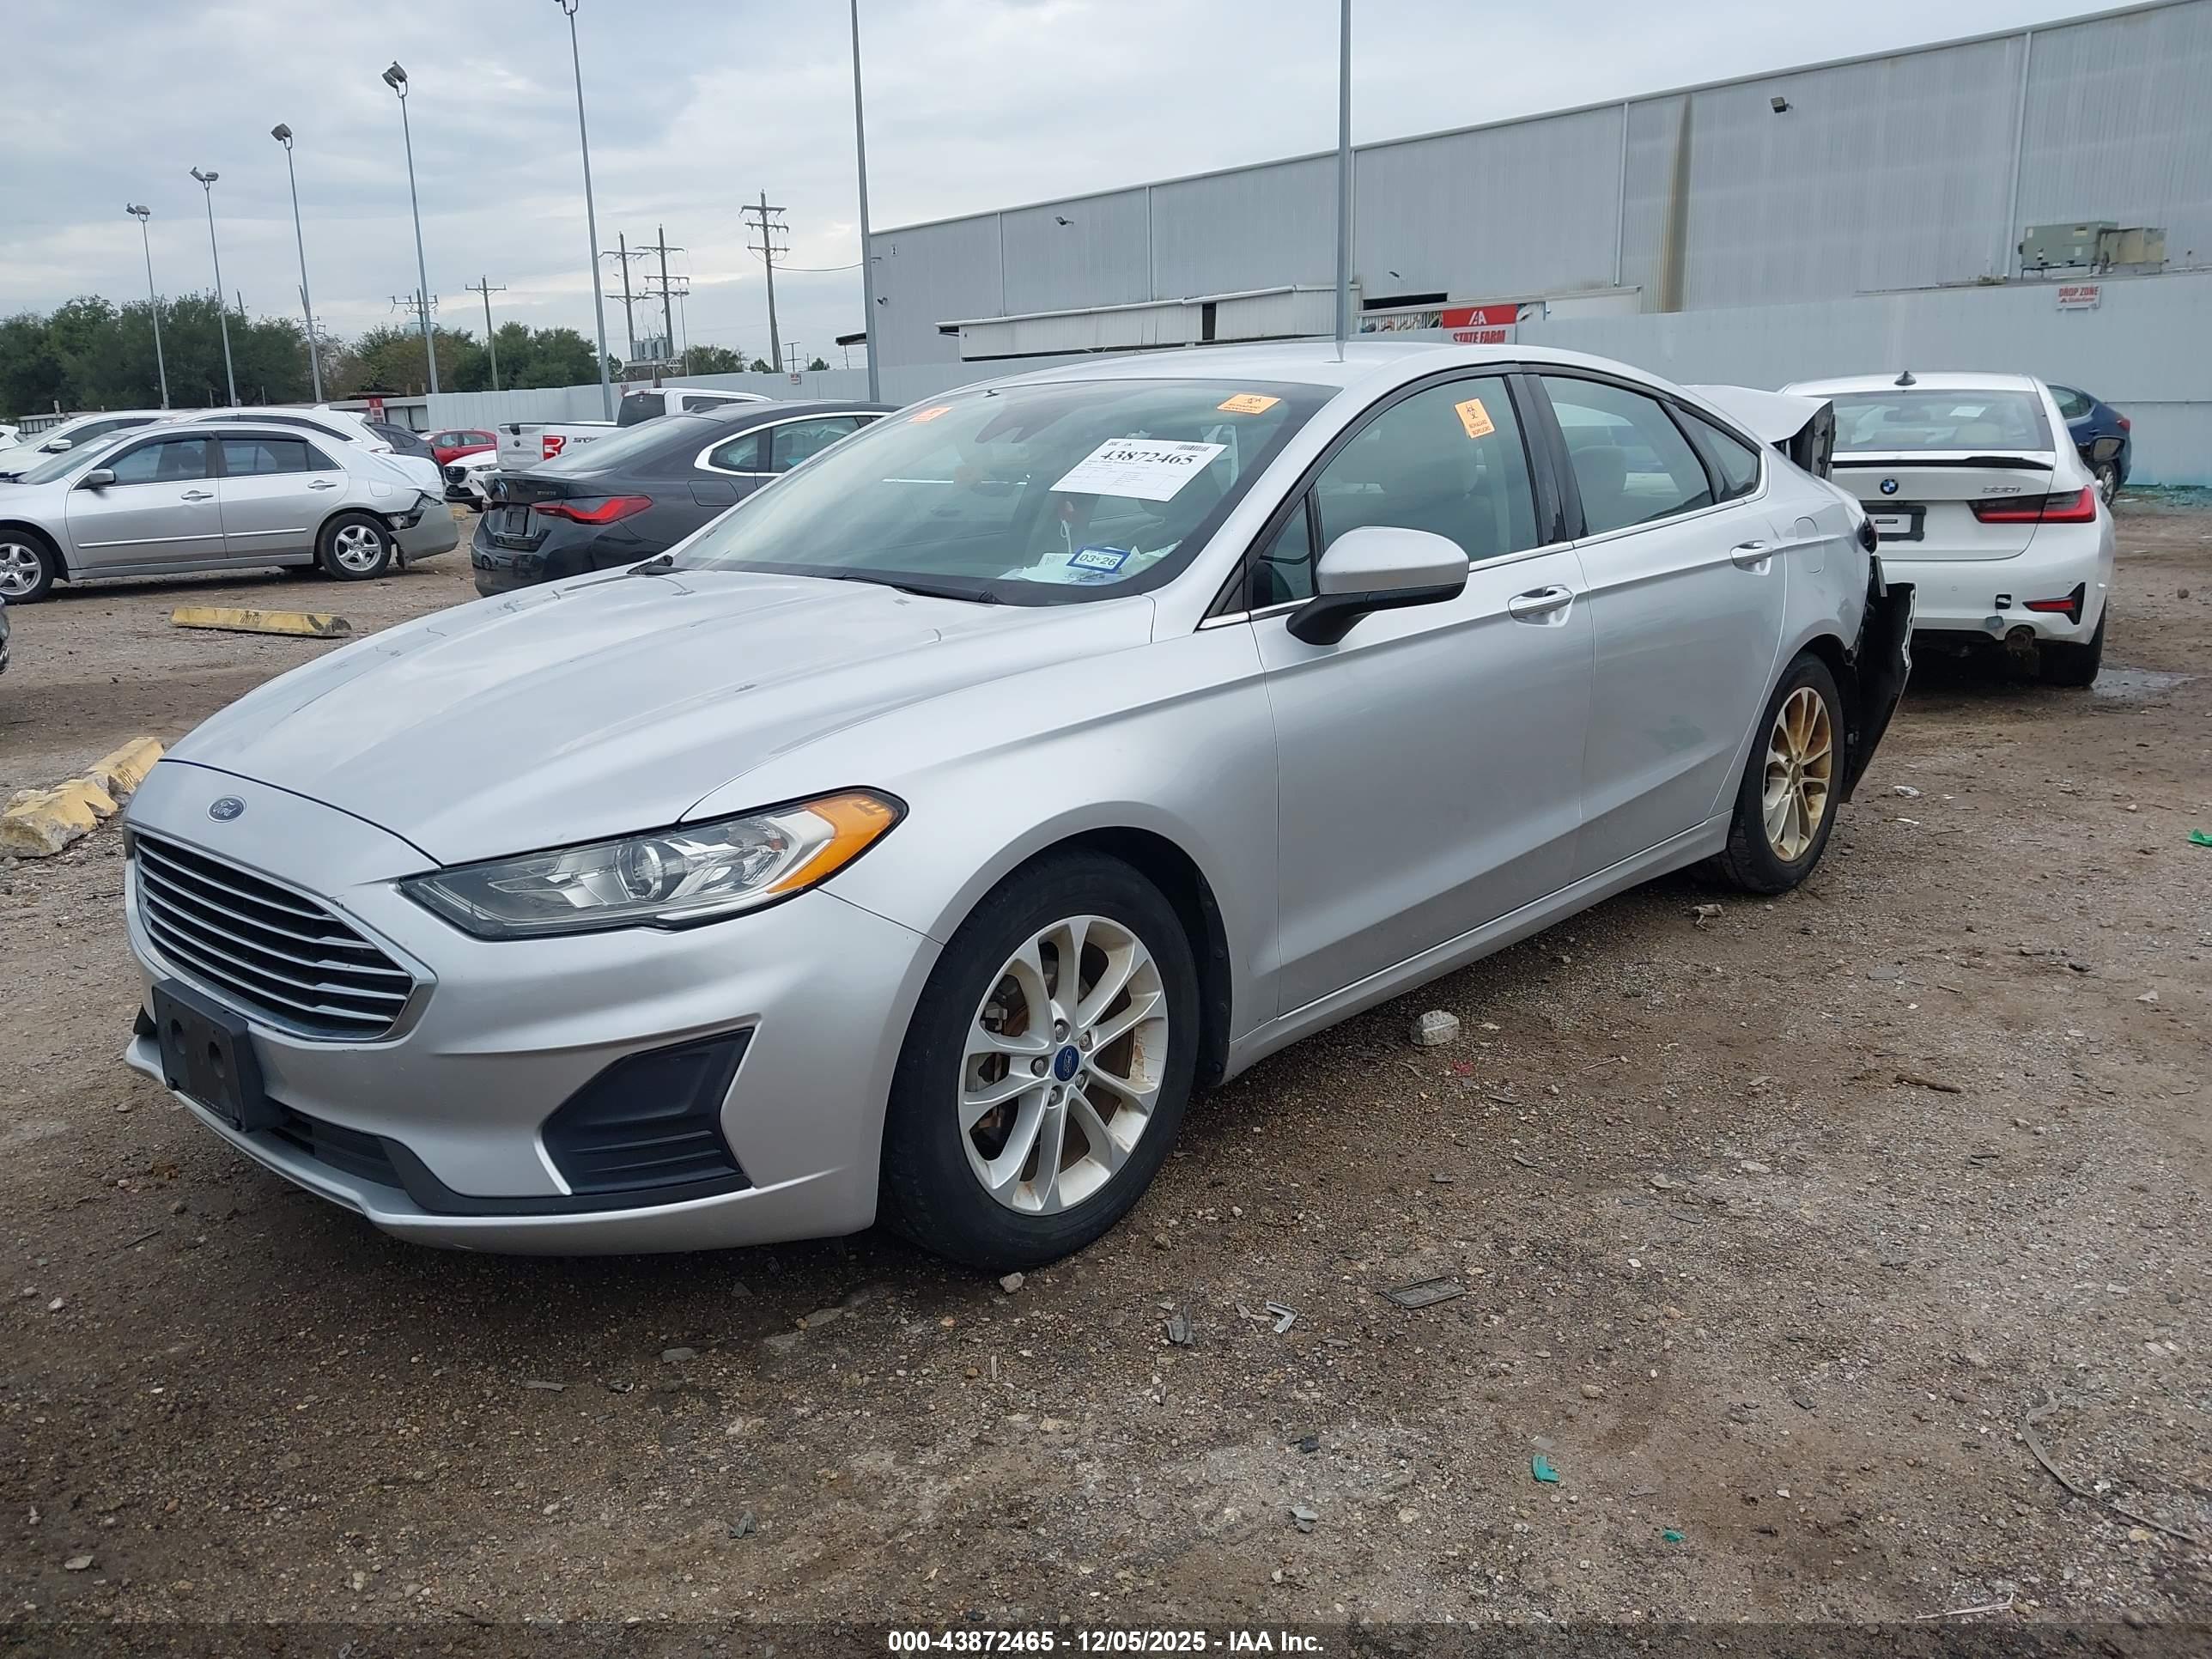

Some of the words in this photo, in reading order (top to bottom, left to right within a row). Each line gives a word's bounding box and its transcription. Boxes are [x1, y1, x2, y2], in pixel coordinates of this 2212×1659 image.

[2058, 288, 2079, 297] DROP
[2080, 286, 2100, 296] ZONE
[1452, 331, 1479, 343] STATE
[1480, 329, 1507, 343] FARM
[1100, 449, 1199, 466] 43872465
[213, 799, 238, 817] Ford
